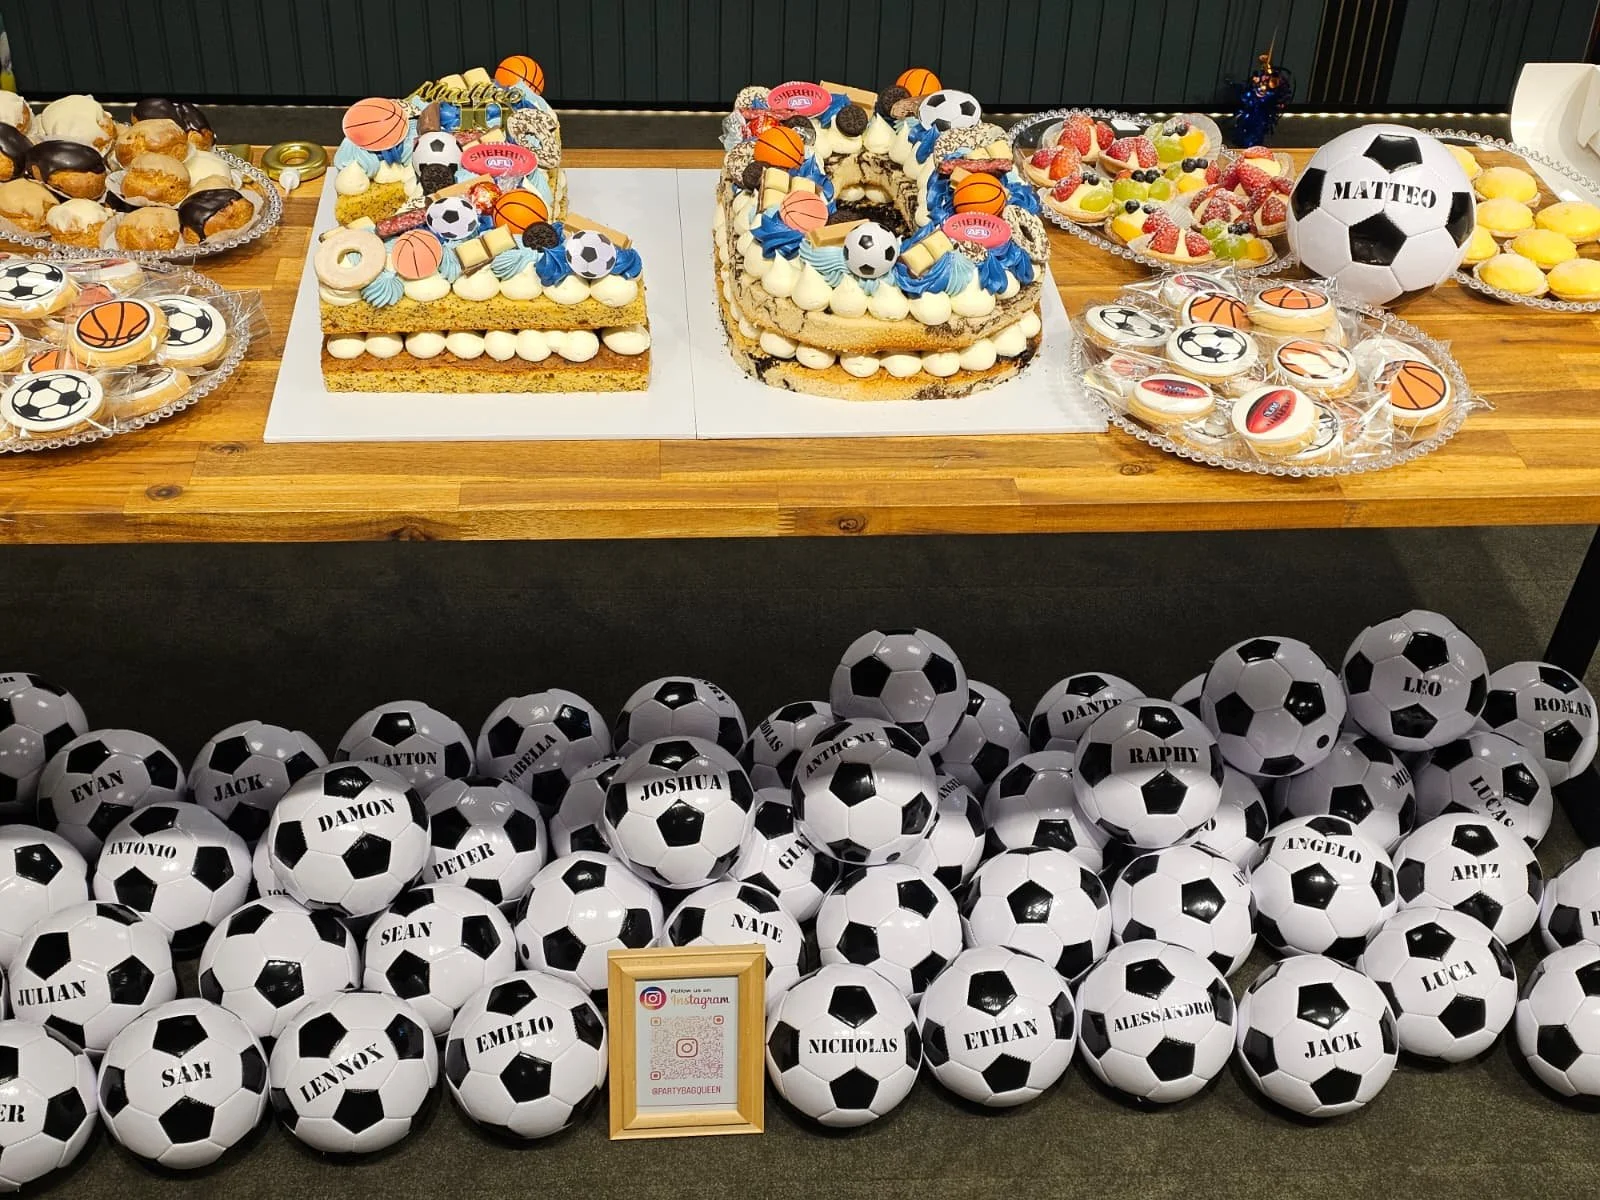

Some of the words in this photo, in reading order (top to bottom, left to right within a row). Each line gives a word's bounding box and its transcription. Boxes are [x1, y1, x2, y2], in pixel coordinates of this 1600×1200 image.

[488, 159, 511, 168] AFL
[1332, 181, 1437, 209] MATTEO
[1403, 677, 1442, 697] LEO
[1533, 697, 1592, 718] ROMAN
[805, 731, 876, 778] ANTHONY
[1129, 747, 1199, 764] RAPHY
[70, 770, 125, 804] EVAN
[214, 774, 264, 802] JACK
[640, 774, 722, 802] JOSHUA
[317, 798, 396, 833] DAMON
[107, 842, 177, 860] ANTONIO
[432, 842, 496, 880] PETER
[1282, 837, 1362, 864] ANGELO
[380, 921, 433, 946] SEAN
[731, 913, 784, 943] NATE
[1421, 960, 1477, 993] LUCA
[18, 980, 87, 1006] JULIAN
[671, 994, 730, 1009] Instagram
[1113, 1000, 1213, 1032] ALESSANDRO
[475, 1016, 554, 1053] EMILIO
[808, 1037, 898, 1054] NICHOLAS
[964, 1018, 1040, 1050] ETHAN
[1304, 1031, 1363, 1060] JACK
[161, 1061, 213, 1089] SAM
[299, 1043, 386, 1104] LENNOX
[651, 1085, 721, 1096] @PARTYBAGQUEEN
